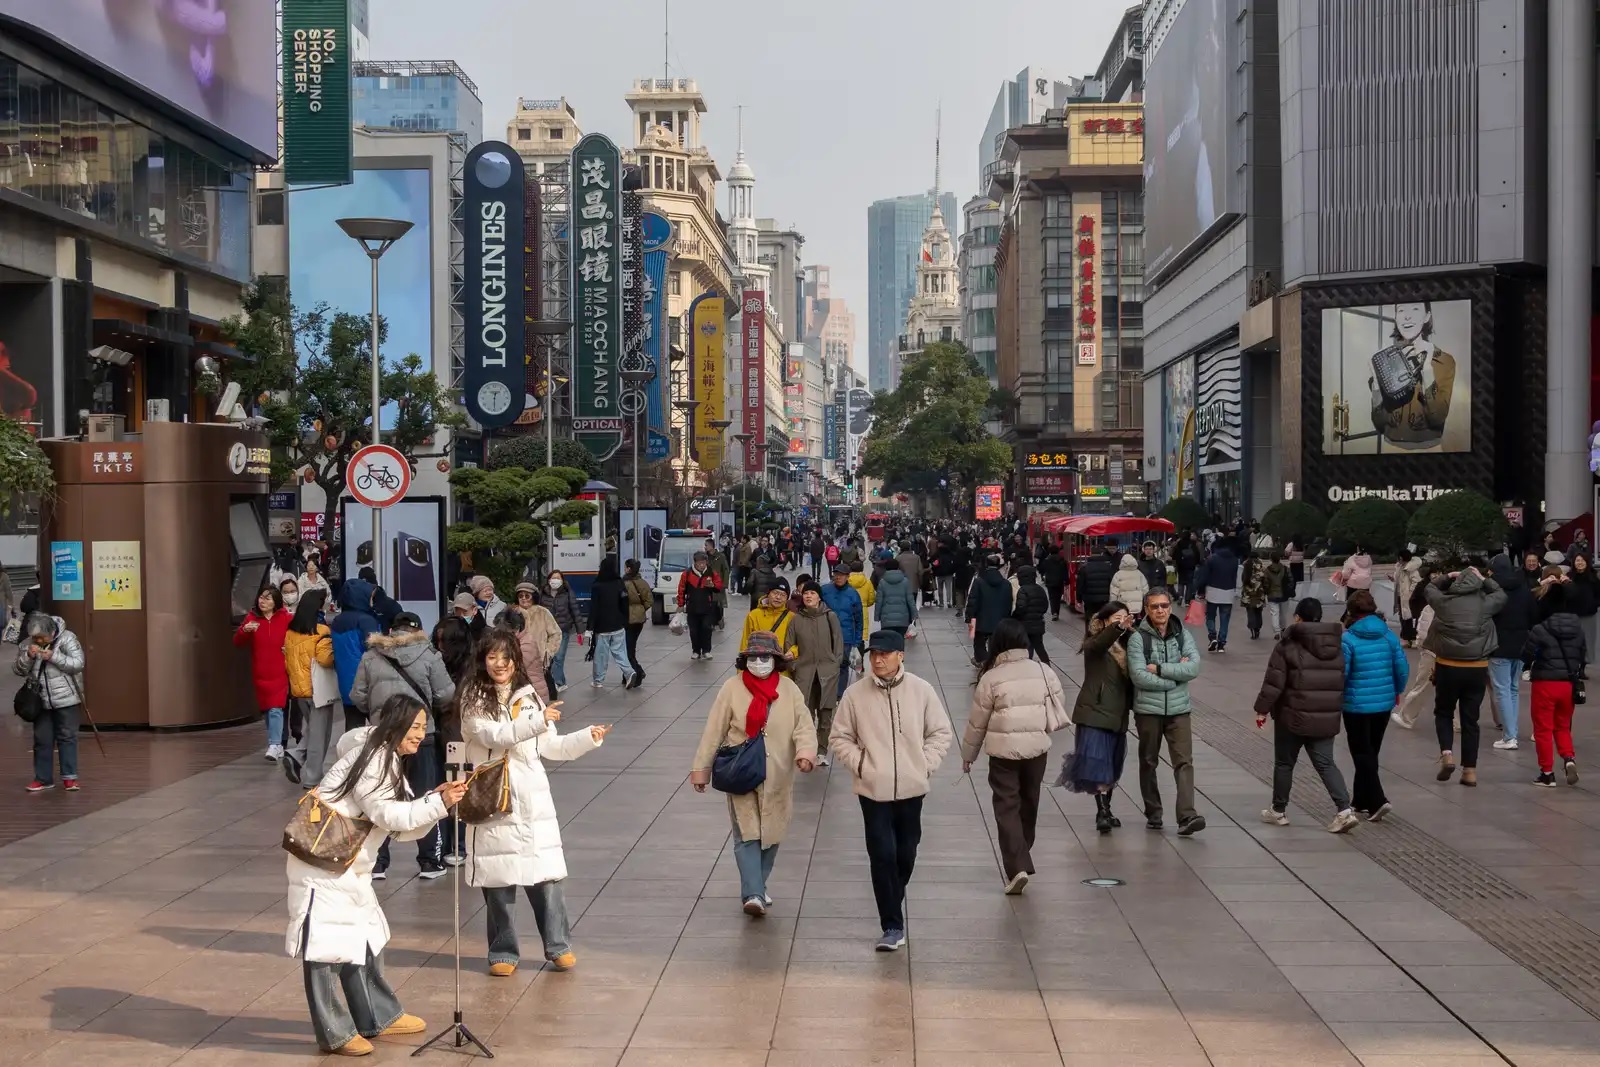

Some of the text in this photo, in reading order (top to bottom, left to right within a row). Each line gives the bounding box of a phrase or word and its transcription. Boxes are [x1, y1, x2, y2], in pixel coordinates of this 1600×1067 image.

[294, 28, 307, 94] CENTER
[323, 28, 336, 64] NO.1
[308, 28, 322, 113] SHOPPING
[579, 157, 612, 282] 茂昌眼镜
[481, 200, 507, 368] LONGINES
[584, 287, 592, 345] SINCE 1923
[593, 286, 608, 409] MAOCHANG
[748, 318, 759, 408] 上海市第一食品商店
[573, 419, 622, 430] OPTICAL
[749, 412, 758, 429] First
[1196, 401, 1223, 434] SEPHORA
[93, 463, 133, 473] TKTS
[1028, 453, 1068, 465] 汤包馆
[1328, 485, 1463, 502] Onitsuka Tig
